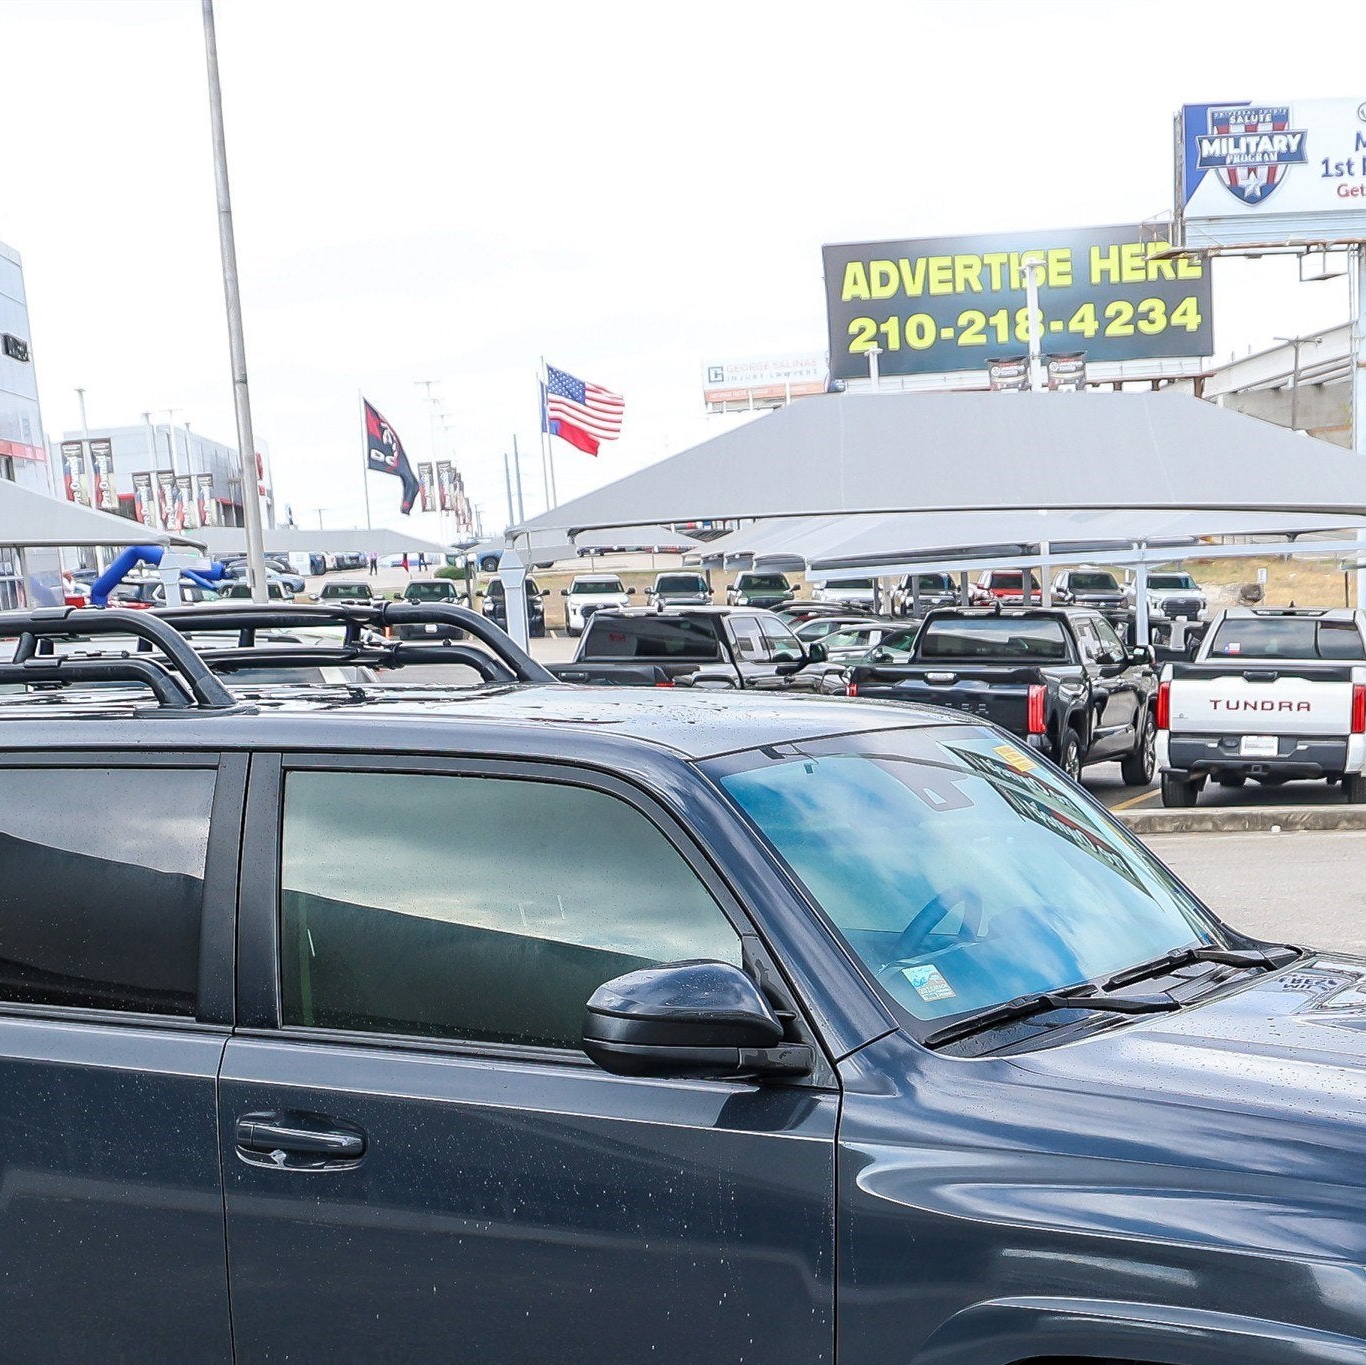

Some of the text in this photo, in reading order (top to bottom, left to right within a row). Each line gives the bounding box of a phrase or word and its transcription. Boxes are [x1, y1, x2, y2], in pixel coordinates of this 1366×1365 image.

[1229, 113, 1272, 124] SALUTE
[1201, 133, 1302, 158] MILITARY
[1321, 157, 1355, 178] 1st
[1336, 182, 1366, 199] Get
[1209, 699, 1312, 712] TUNDRA
